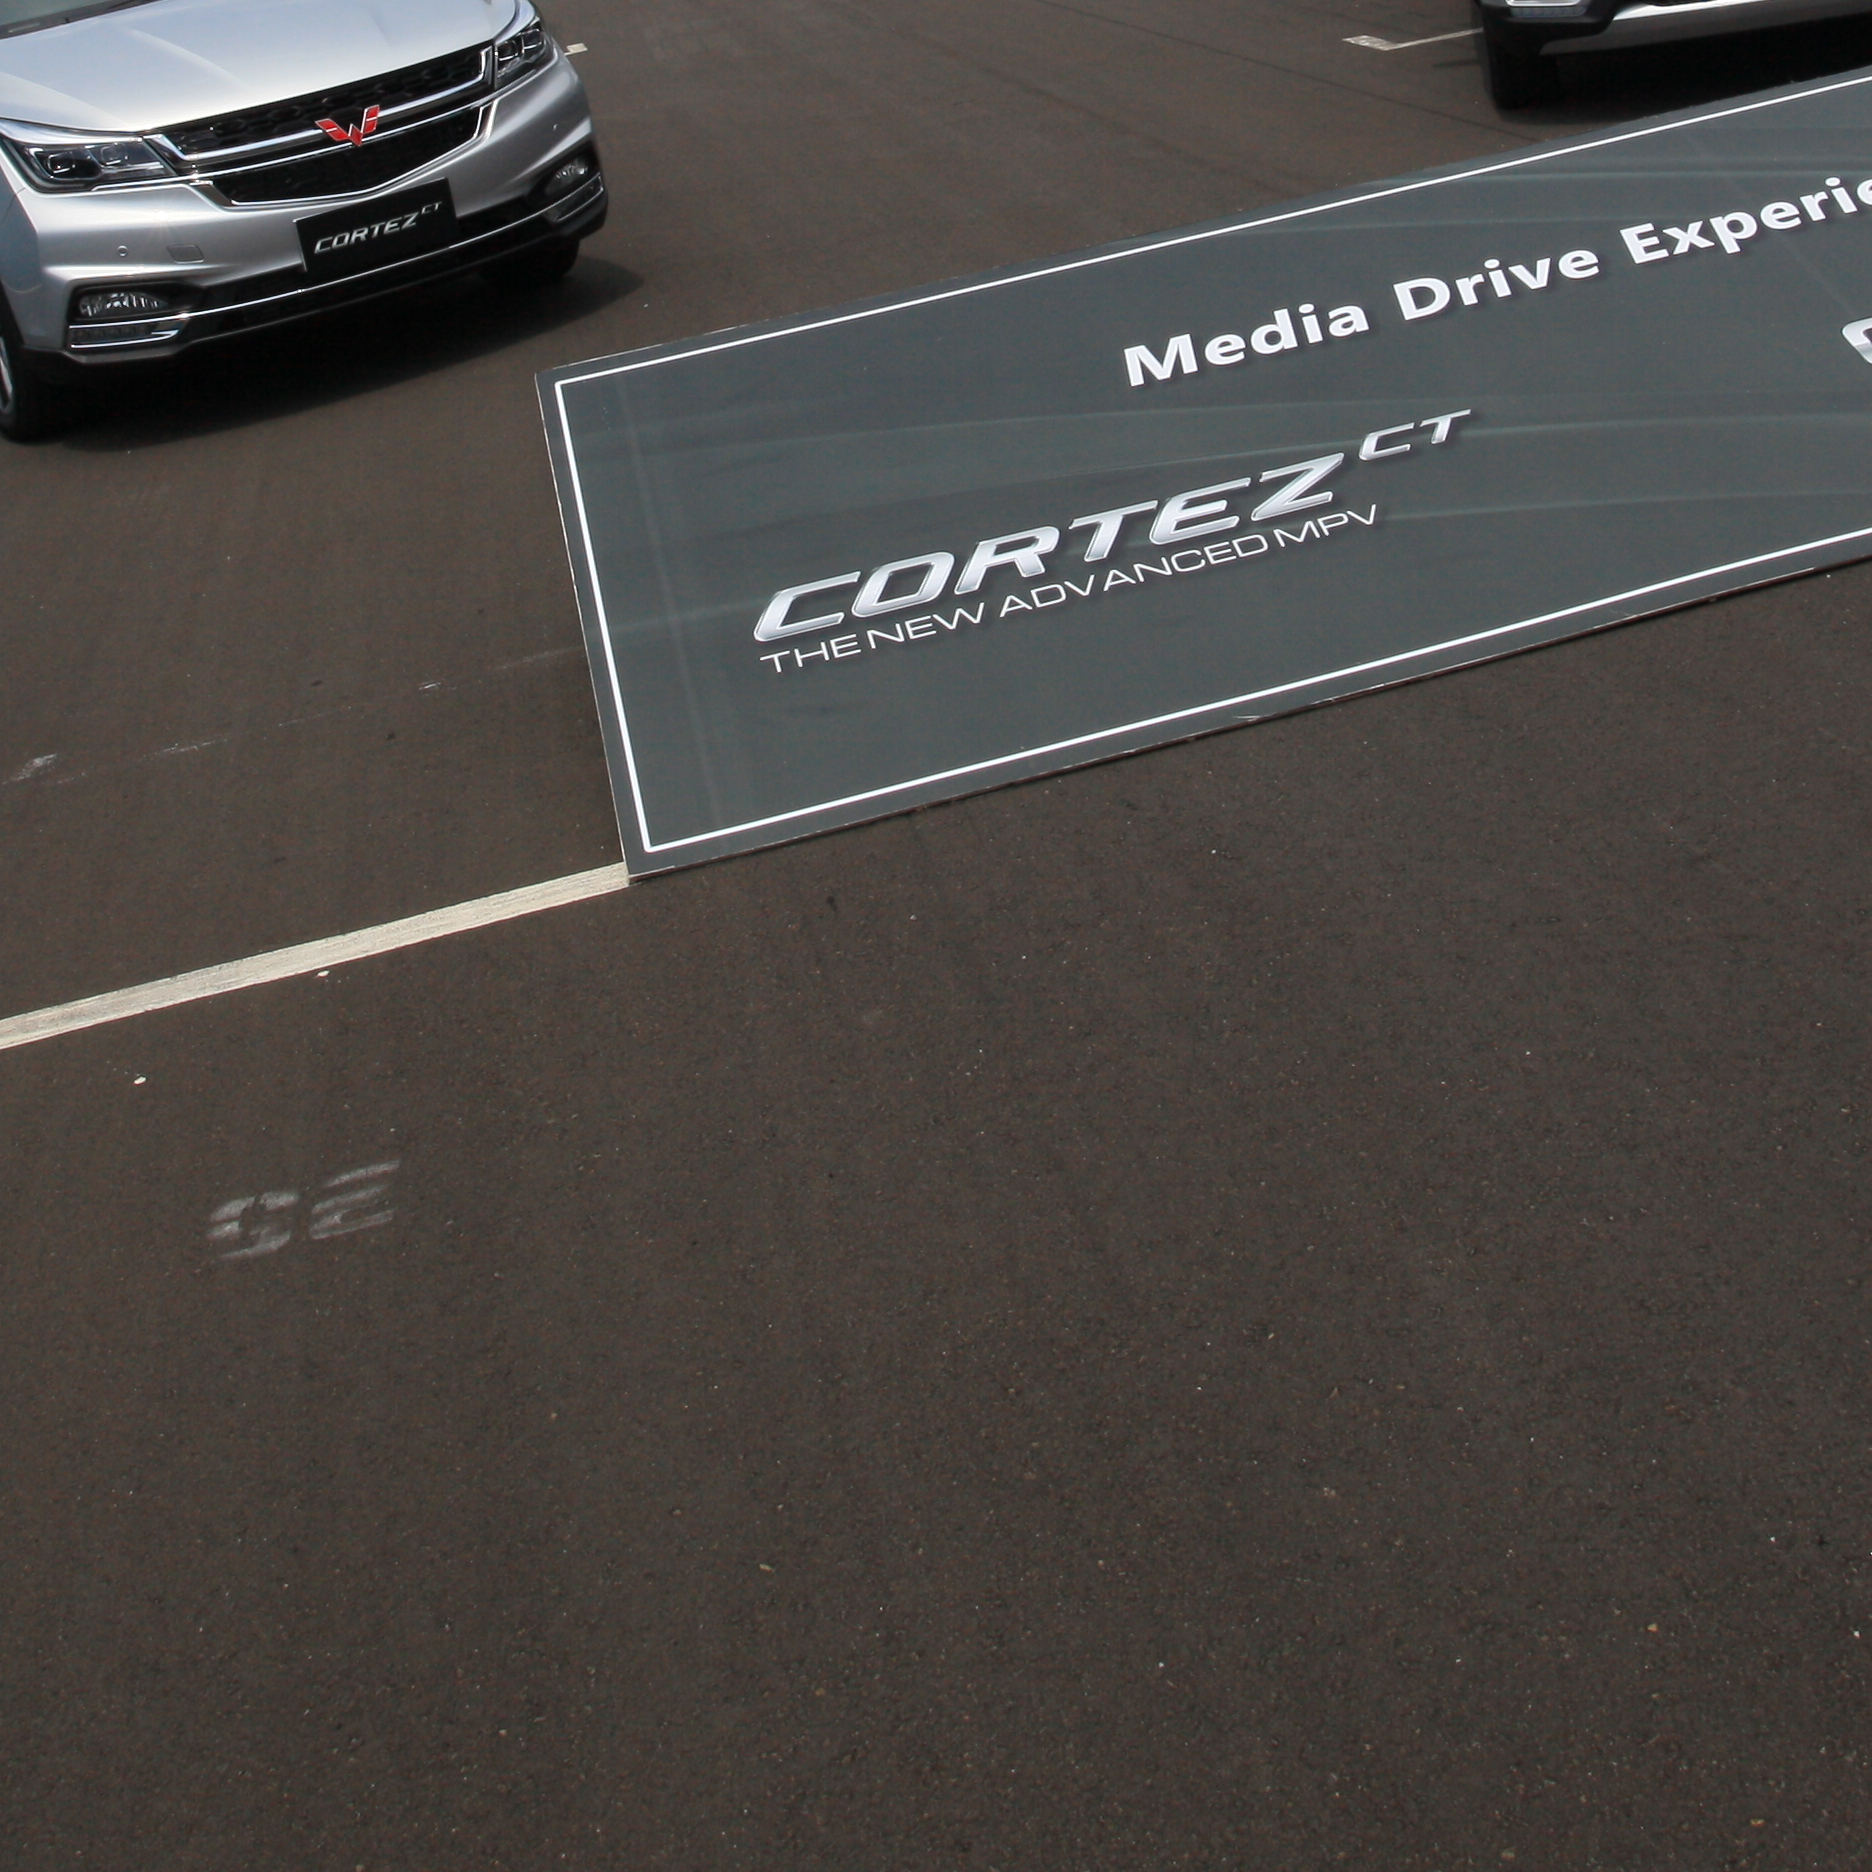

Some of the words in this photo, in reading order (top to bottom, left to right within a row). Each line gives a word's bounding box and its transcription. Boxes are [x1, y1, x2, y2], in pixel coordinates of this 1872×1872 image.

[314, 211, 420, 255] CORTEZ
[420, 201, 442, 215] CT
[1123, 303, 1369, 387] Media
[1392, 246, 1600, 323] Drive
[753, 452, 1346, 642] CORTEZ
[1358, 408, 1472, 461] CT
[759, 634, 862, 673] THE
[869, 602, 986, 650] NEW
[998, 533, 1269, 618] ADVANCED
[1271, 504, 1378, 550] MPV
